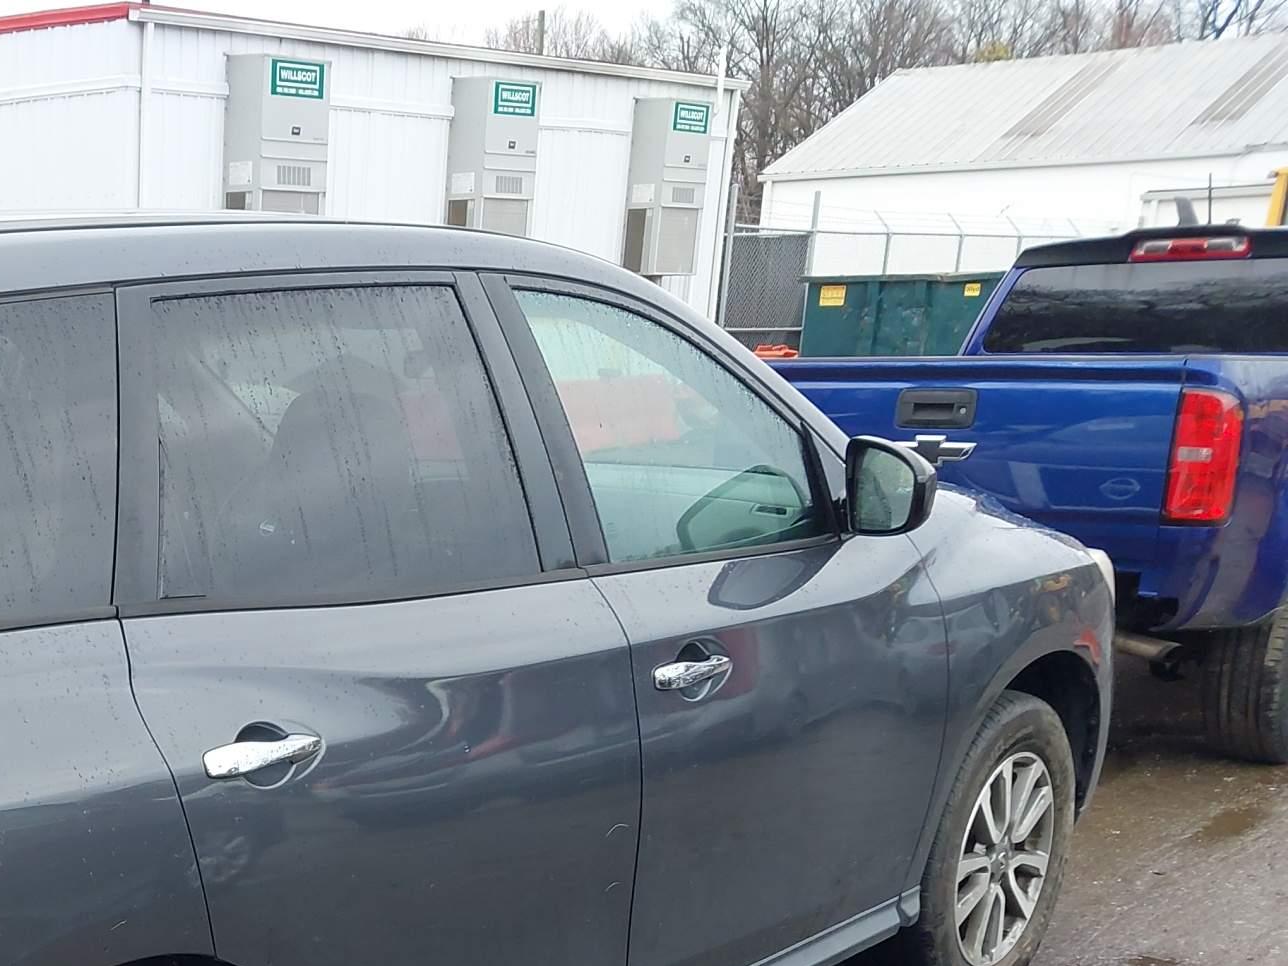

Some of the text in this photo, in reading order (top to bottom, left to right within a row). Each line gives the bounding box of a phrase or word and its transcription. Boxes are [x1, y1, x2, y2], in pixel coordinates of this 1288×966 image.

[280, 68, 316, 82] WILLSCOT
[501, 91, 530, 103] WILLSCOT
[680, 109, 704, 122] WILLSCOT
